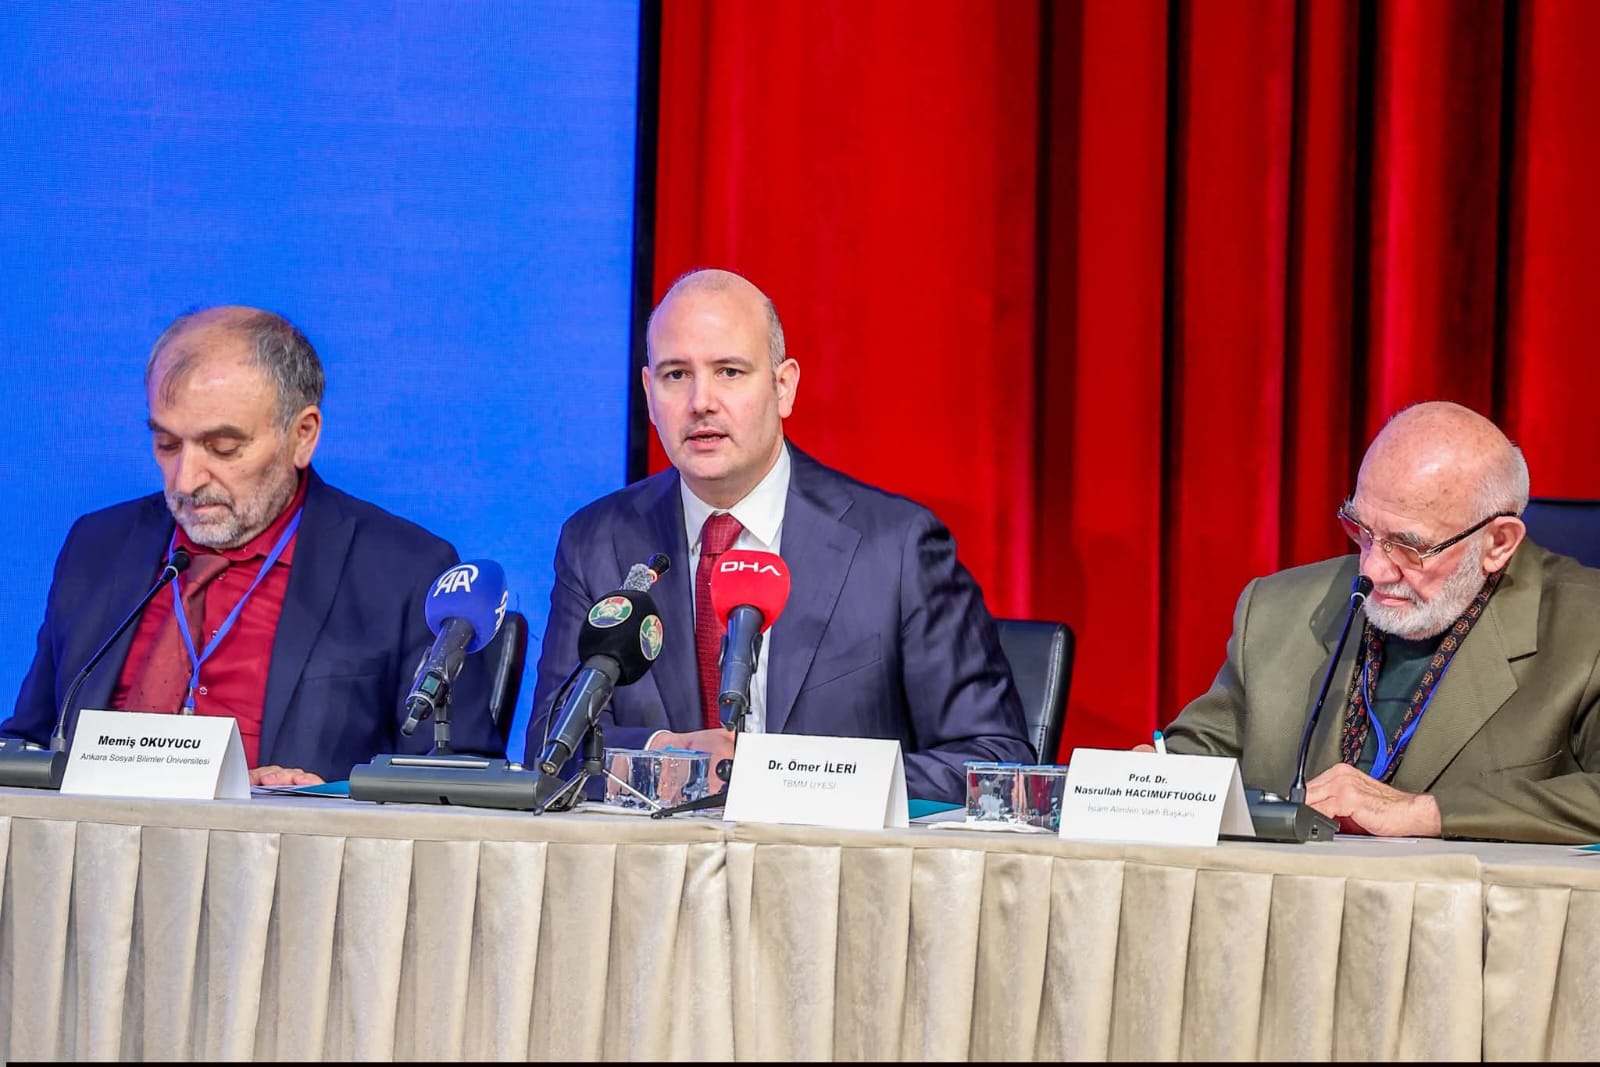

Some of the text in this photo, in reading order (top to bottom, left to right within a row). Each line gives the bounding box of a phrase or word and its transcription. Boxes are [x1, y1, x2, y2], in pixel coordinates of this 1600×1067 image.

[720, 560, 782, 577] DHA
[98, 735, 201, 749] Memiş OKUYUCU
[80, 752, 107, 761] Ankara
[109, 754, 135, 763] Sosyal
[136, 755, 164, 764] Bilimler
[768, 759, 784, 771] Dr.
[1128, 773, 1168, 784] Prof. Dr.
[1074, 785, 1122, 797] Nasrullah
